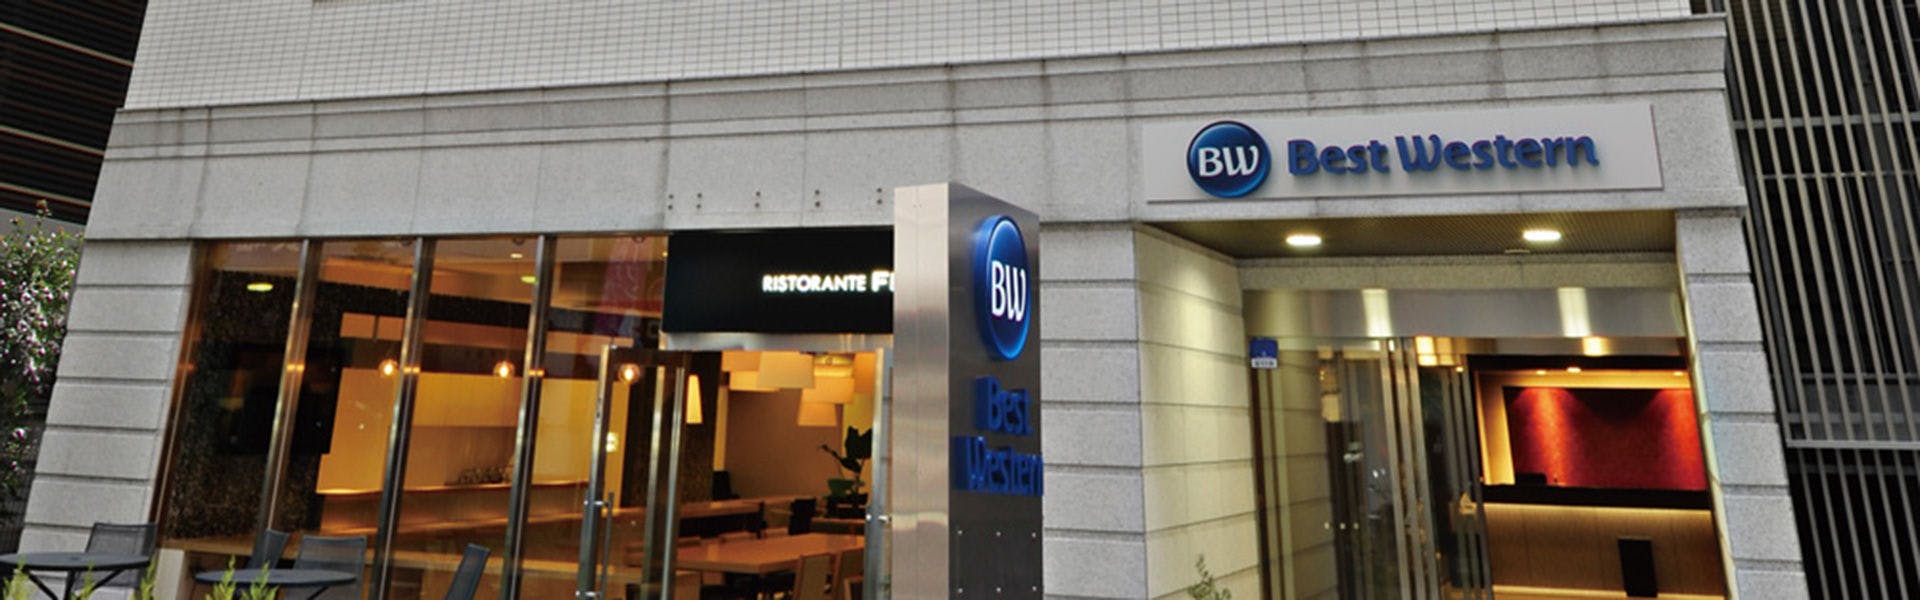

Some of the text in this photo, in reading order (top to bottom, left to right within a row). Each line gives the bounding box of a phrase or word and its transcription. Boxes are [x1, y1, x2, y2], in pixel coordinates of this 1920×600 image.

[1199, 146, 1260, 177] BW
[1287, 134, 1600, 176] Best Western
[762, 274, 867, 293] RISTORANTE
[991, 259, 1027, 322] BW
[984, 377, 1032, 436] Best
[962, 436, 1044, 496] Western
